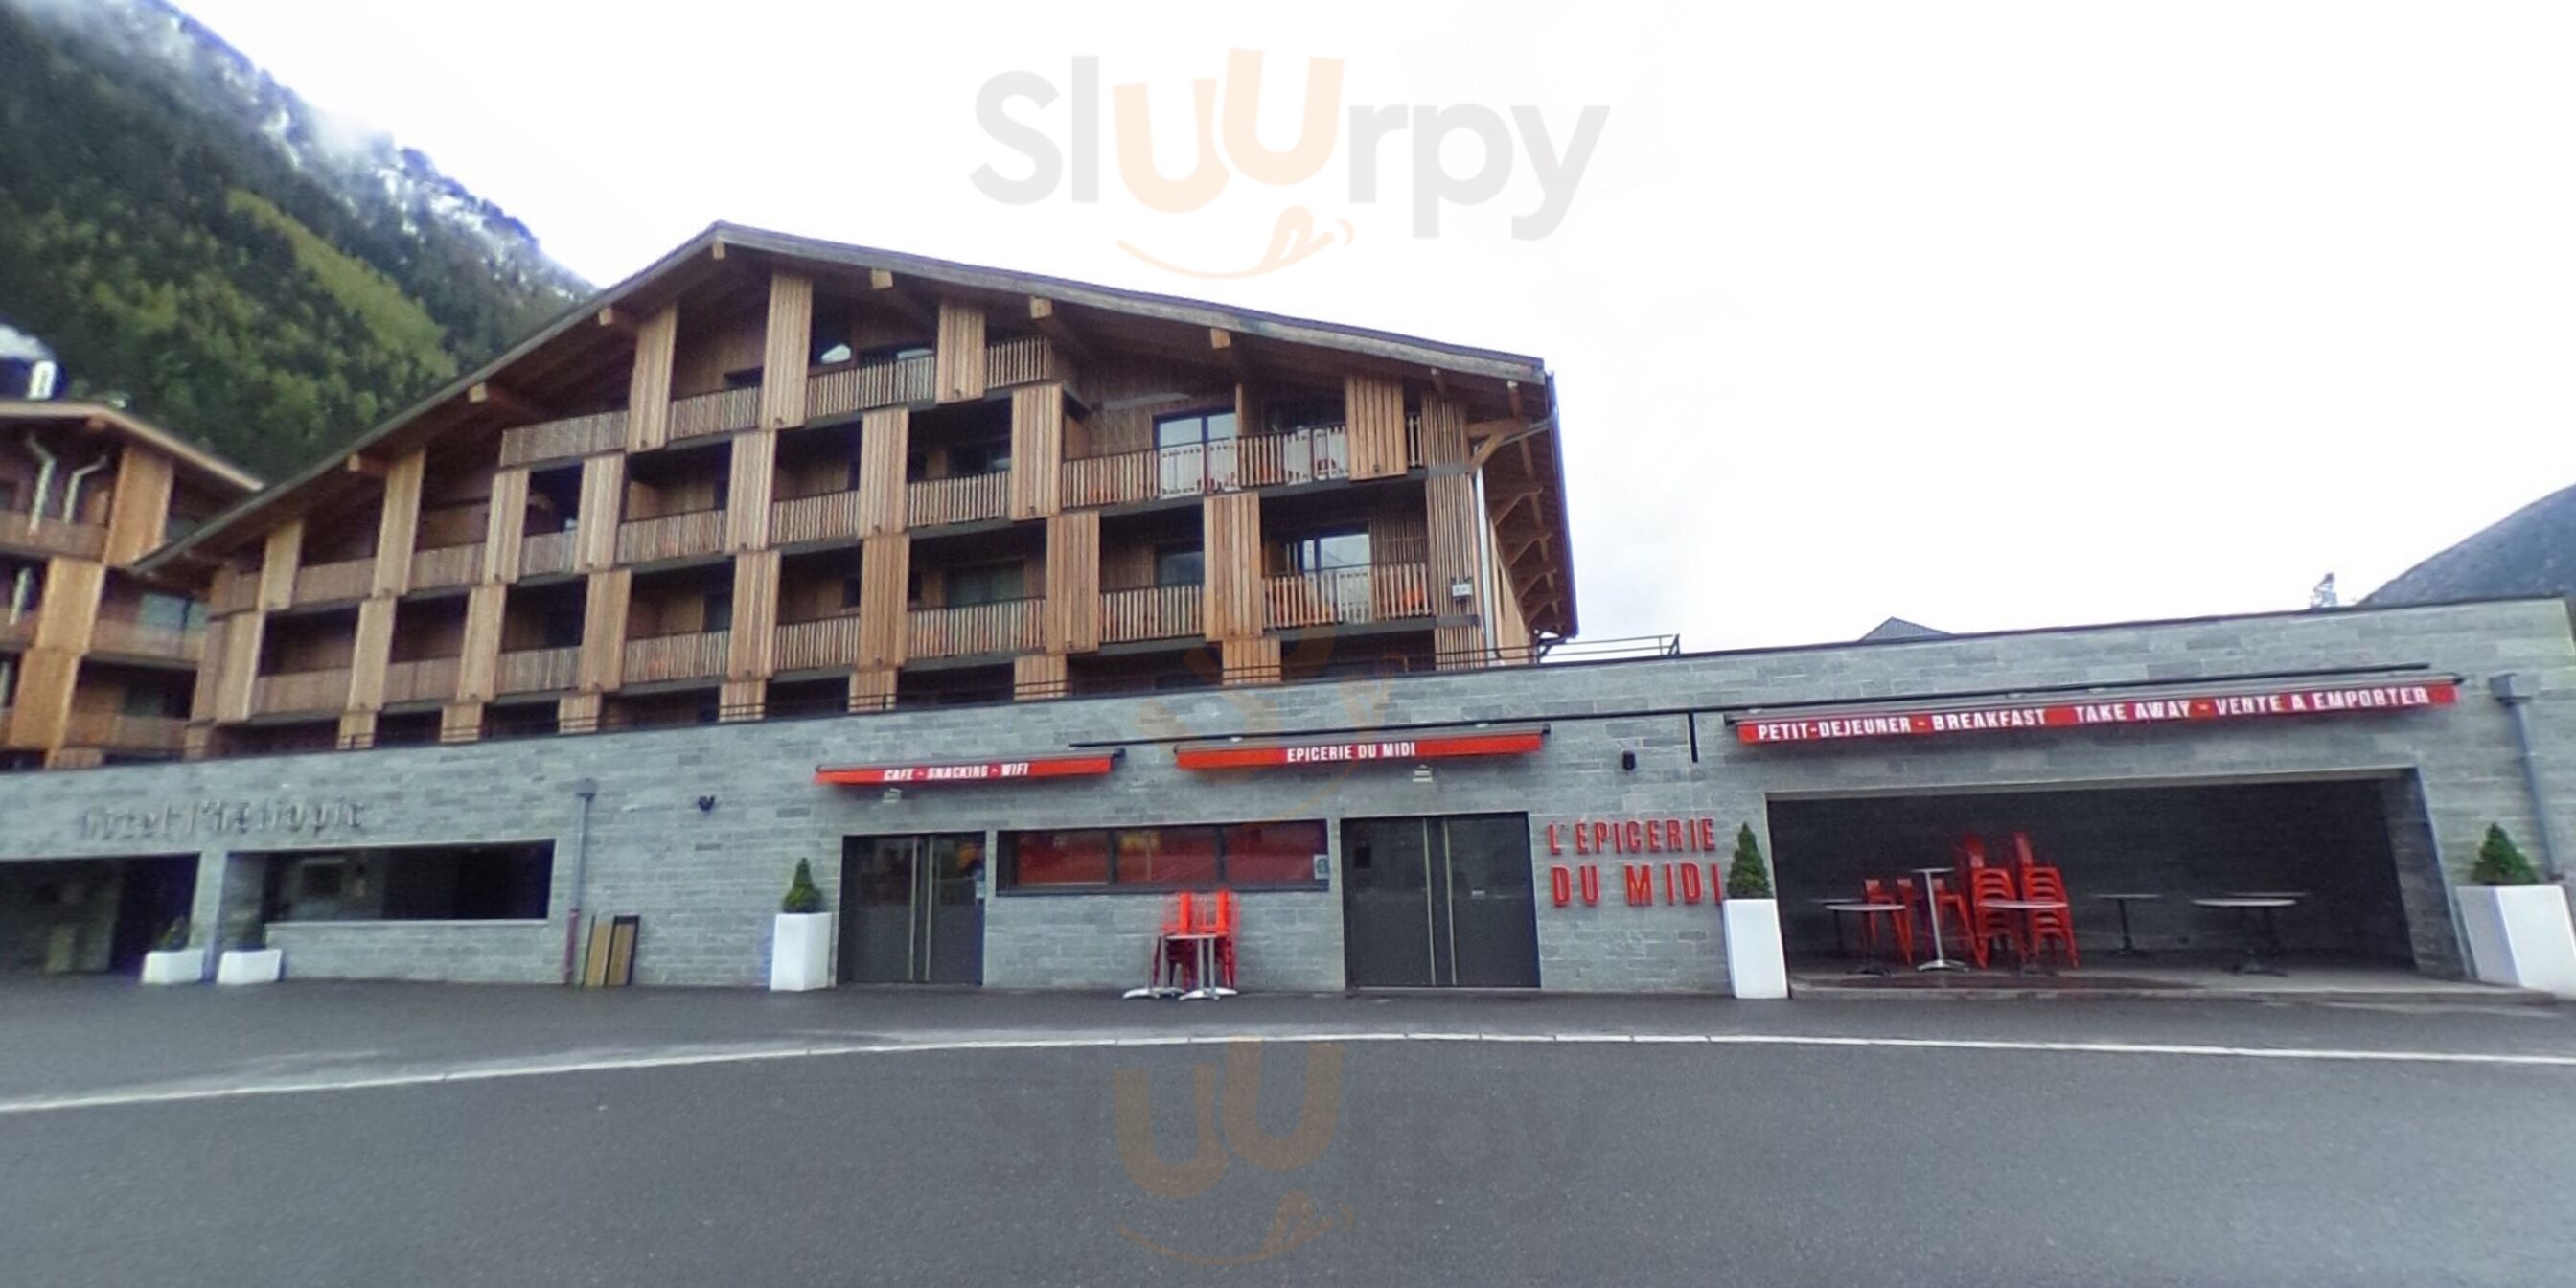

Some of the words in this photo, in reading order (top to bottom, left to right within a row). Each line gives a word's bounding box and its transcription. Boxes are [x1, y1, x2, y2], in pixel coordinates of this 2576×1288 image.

[1758, 717, 1911, 741] PETIT-DEJEUNER
[1932, 708, 2046, 732] BREAKFAST
[2074, 702, 2127, 724] TAKE
[2134, 700, 2192, 722] AWAY
[2214, 695, 2282, 716] VENTE
[2290, 693, 2305, 711] A
[2312, 686, 2430, 711] EMPORTER
[1287, 745, 1352, 763] EPICERIE
[1358, 743, 1377, 759] DU
[1383, 741, 1415, 757] MIDI
[884, 768, 914, 782] CAFE
[927, 765, 988, 780] SNACKING
[1000, 763, 1029, 776] WIFI
[1552, 864, 1601, 907] DU
[1623, 861, 1723, 906] MIDI
